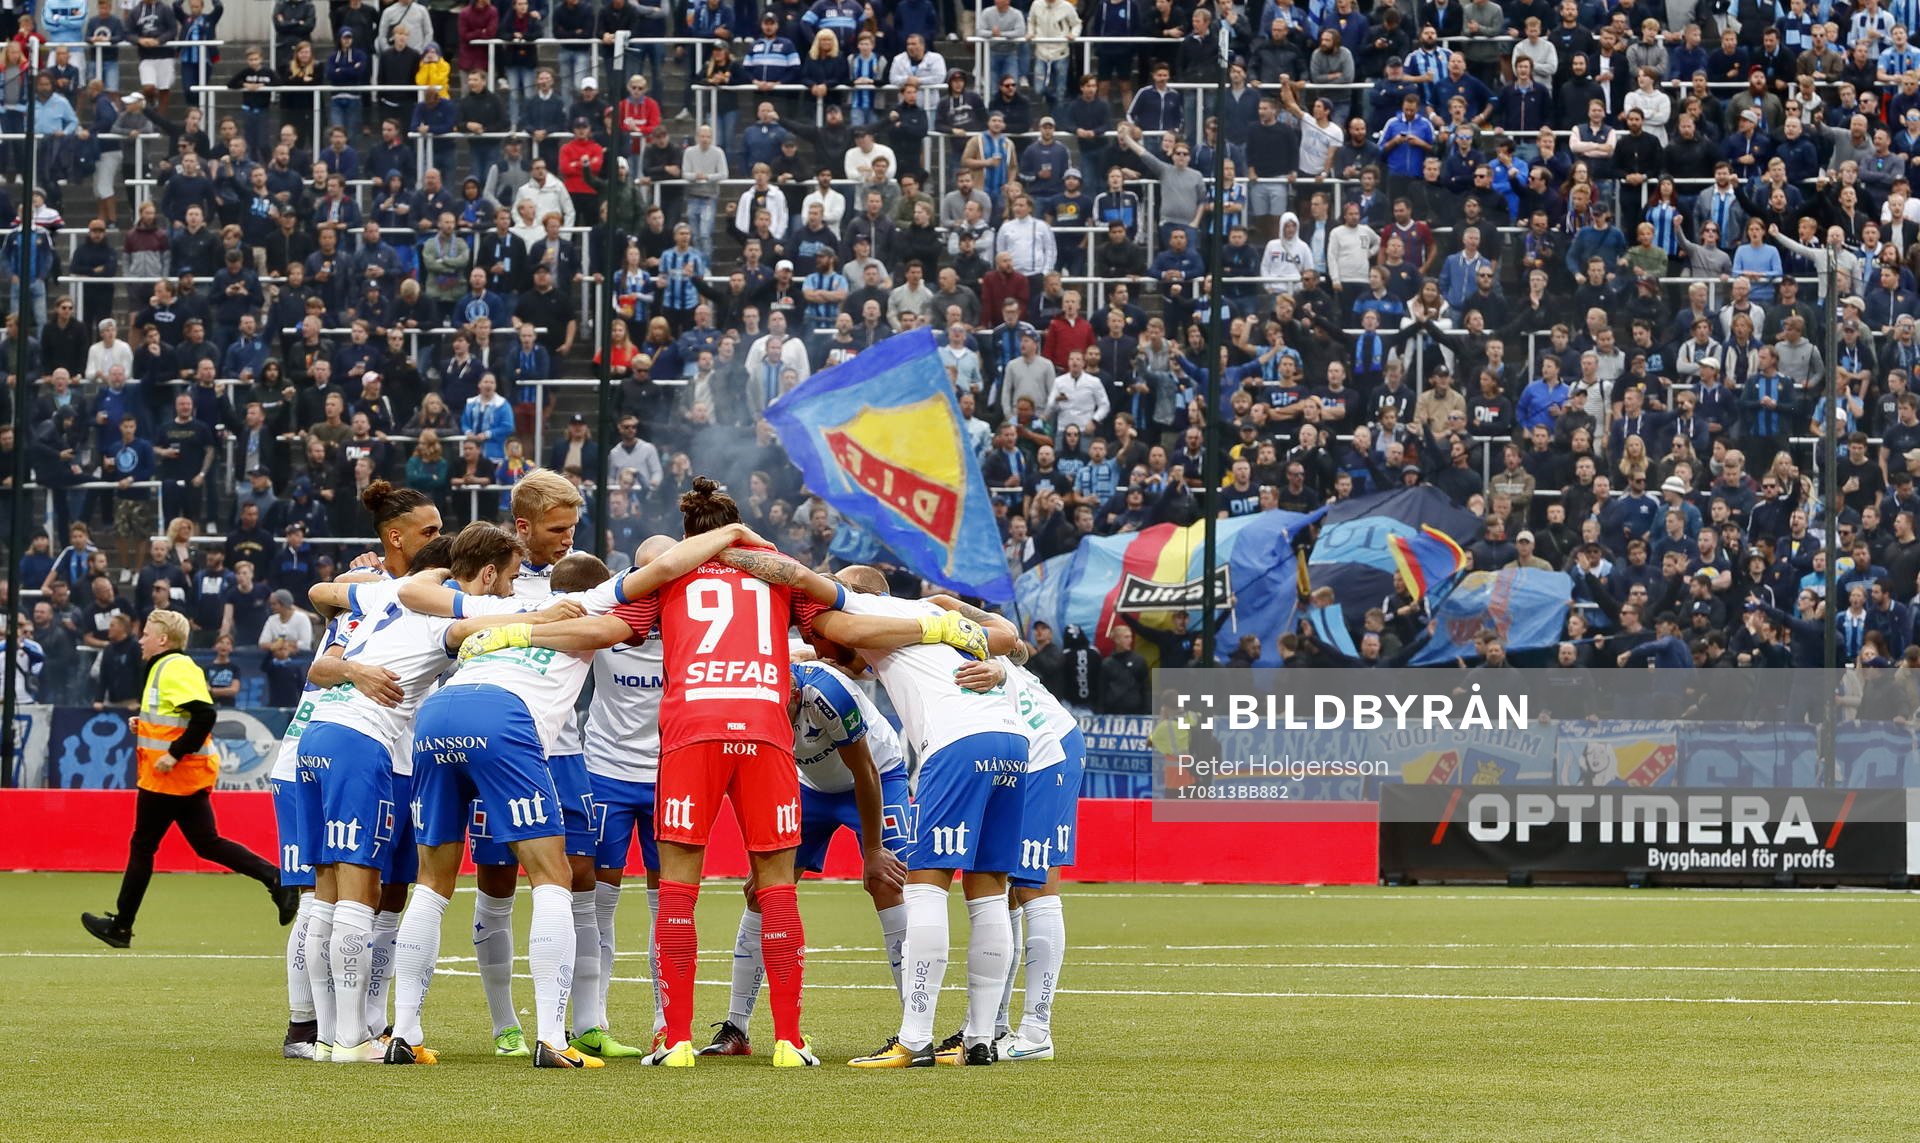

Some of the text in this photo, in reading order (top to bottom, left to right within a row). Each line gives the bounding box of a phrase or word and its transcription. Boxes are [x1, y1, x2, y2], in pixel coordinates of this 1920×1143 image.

[1271, 250, 1301, 264] FILA
[1230, 496, 1259, 513] DIF
[685, 577, 773, 656] 91
[613, 674, 663, 688] HOLM
[684, 660, 779, 685] SEFAB
[1076, 649, 1090, 699] adidas
[415, 736, 488, 753] MÅNSSON
[434, 749, 468, 765] RÖR
[723, 739, 757, 756] RÖR
[974, 755, 1028, 773] MÅNSSO
[991, 771, 1018, 788] RÖR
[508, 790, 549, 828] nt
[664, 794, 695, 831] nt
[776, 797, 799, 834] nt
[1467, 793, 1820, 846] OPTIMERA
[325, 817, 362, 852] nt
[931, 820, 970, 856] nt
[1021, 837, 1053, 871] nt
[1647, 847, 1836, 871] Bygghandel för proffs
[668, 917, 692, 925] PEKING
[764, 931, 787, 939] PEKING
[343, 956, 357, 988] suez
[368, 968, 384, 998] suez
[914, 960, 931, 991] suez
[1040, 971, 1055, 1003] suez
[555, 989, 570, 1024] suez
